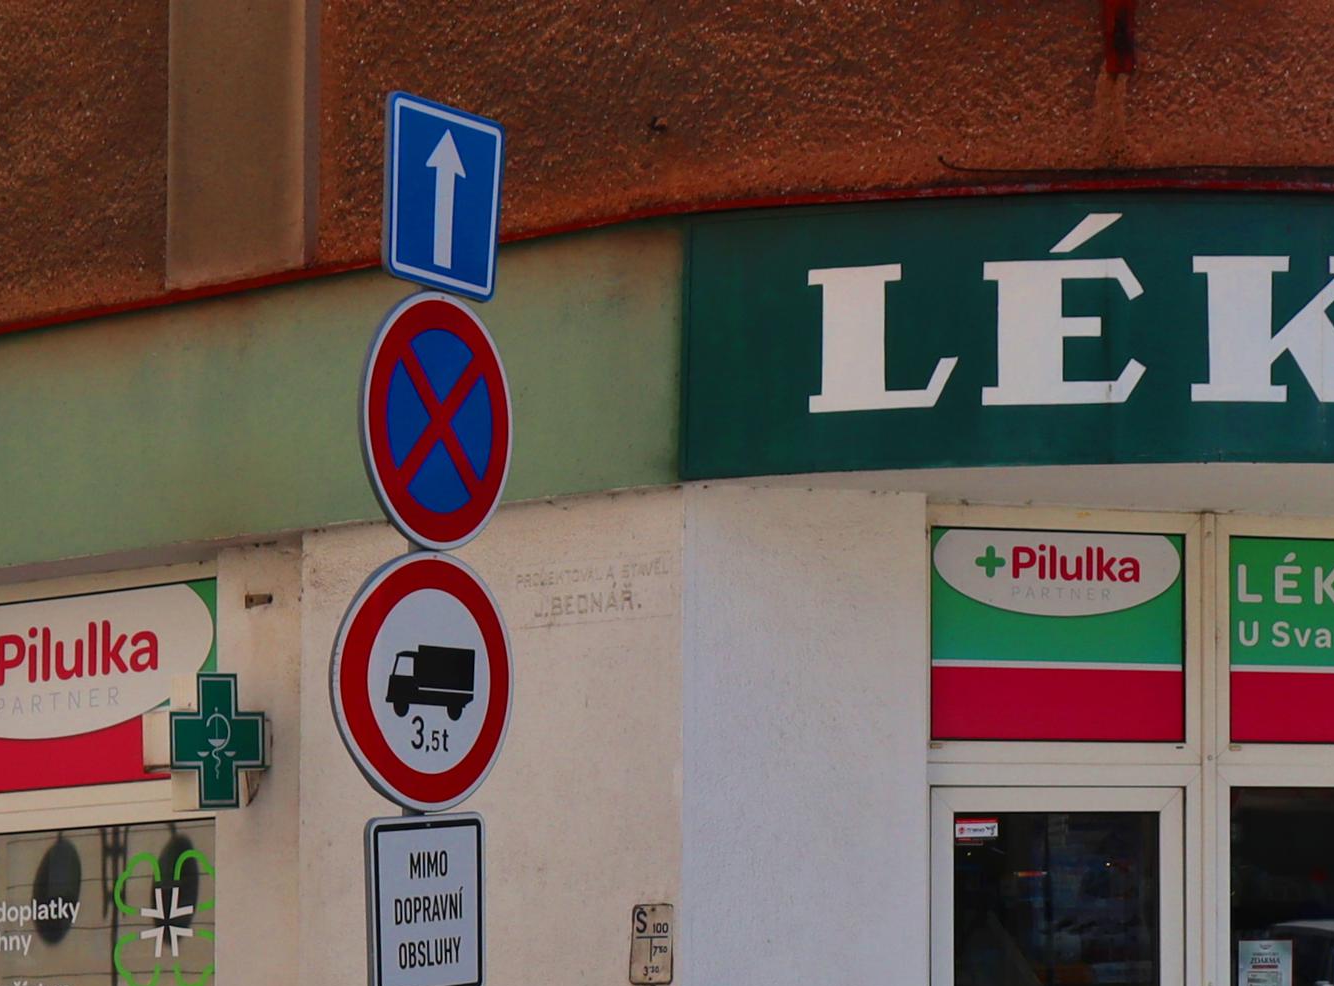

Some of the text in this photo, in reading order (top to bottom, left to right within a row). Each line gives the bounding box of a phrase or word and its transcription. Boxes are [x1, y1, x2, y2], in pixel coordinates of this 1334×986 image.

[1011, 545, 1141, 584] Pilulka
[1011, 585, 1112, 601] PARTNER
[1239, 620, 1260, 647] U
[409, 850, 448, 879] MIMO
[394, 886, 463, 926] DOPRAVNÍ
[636, 907, 669, 933] Š 100
[398, 937, 461, 970] OBSLUHY
